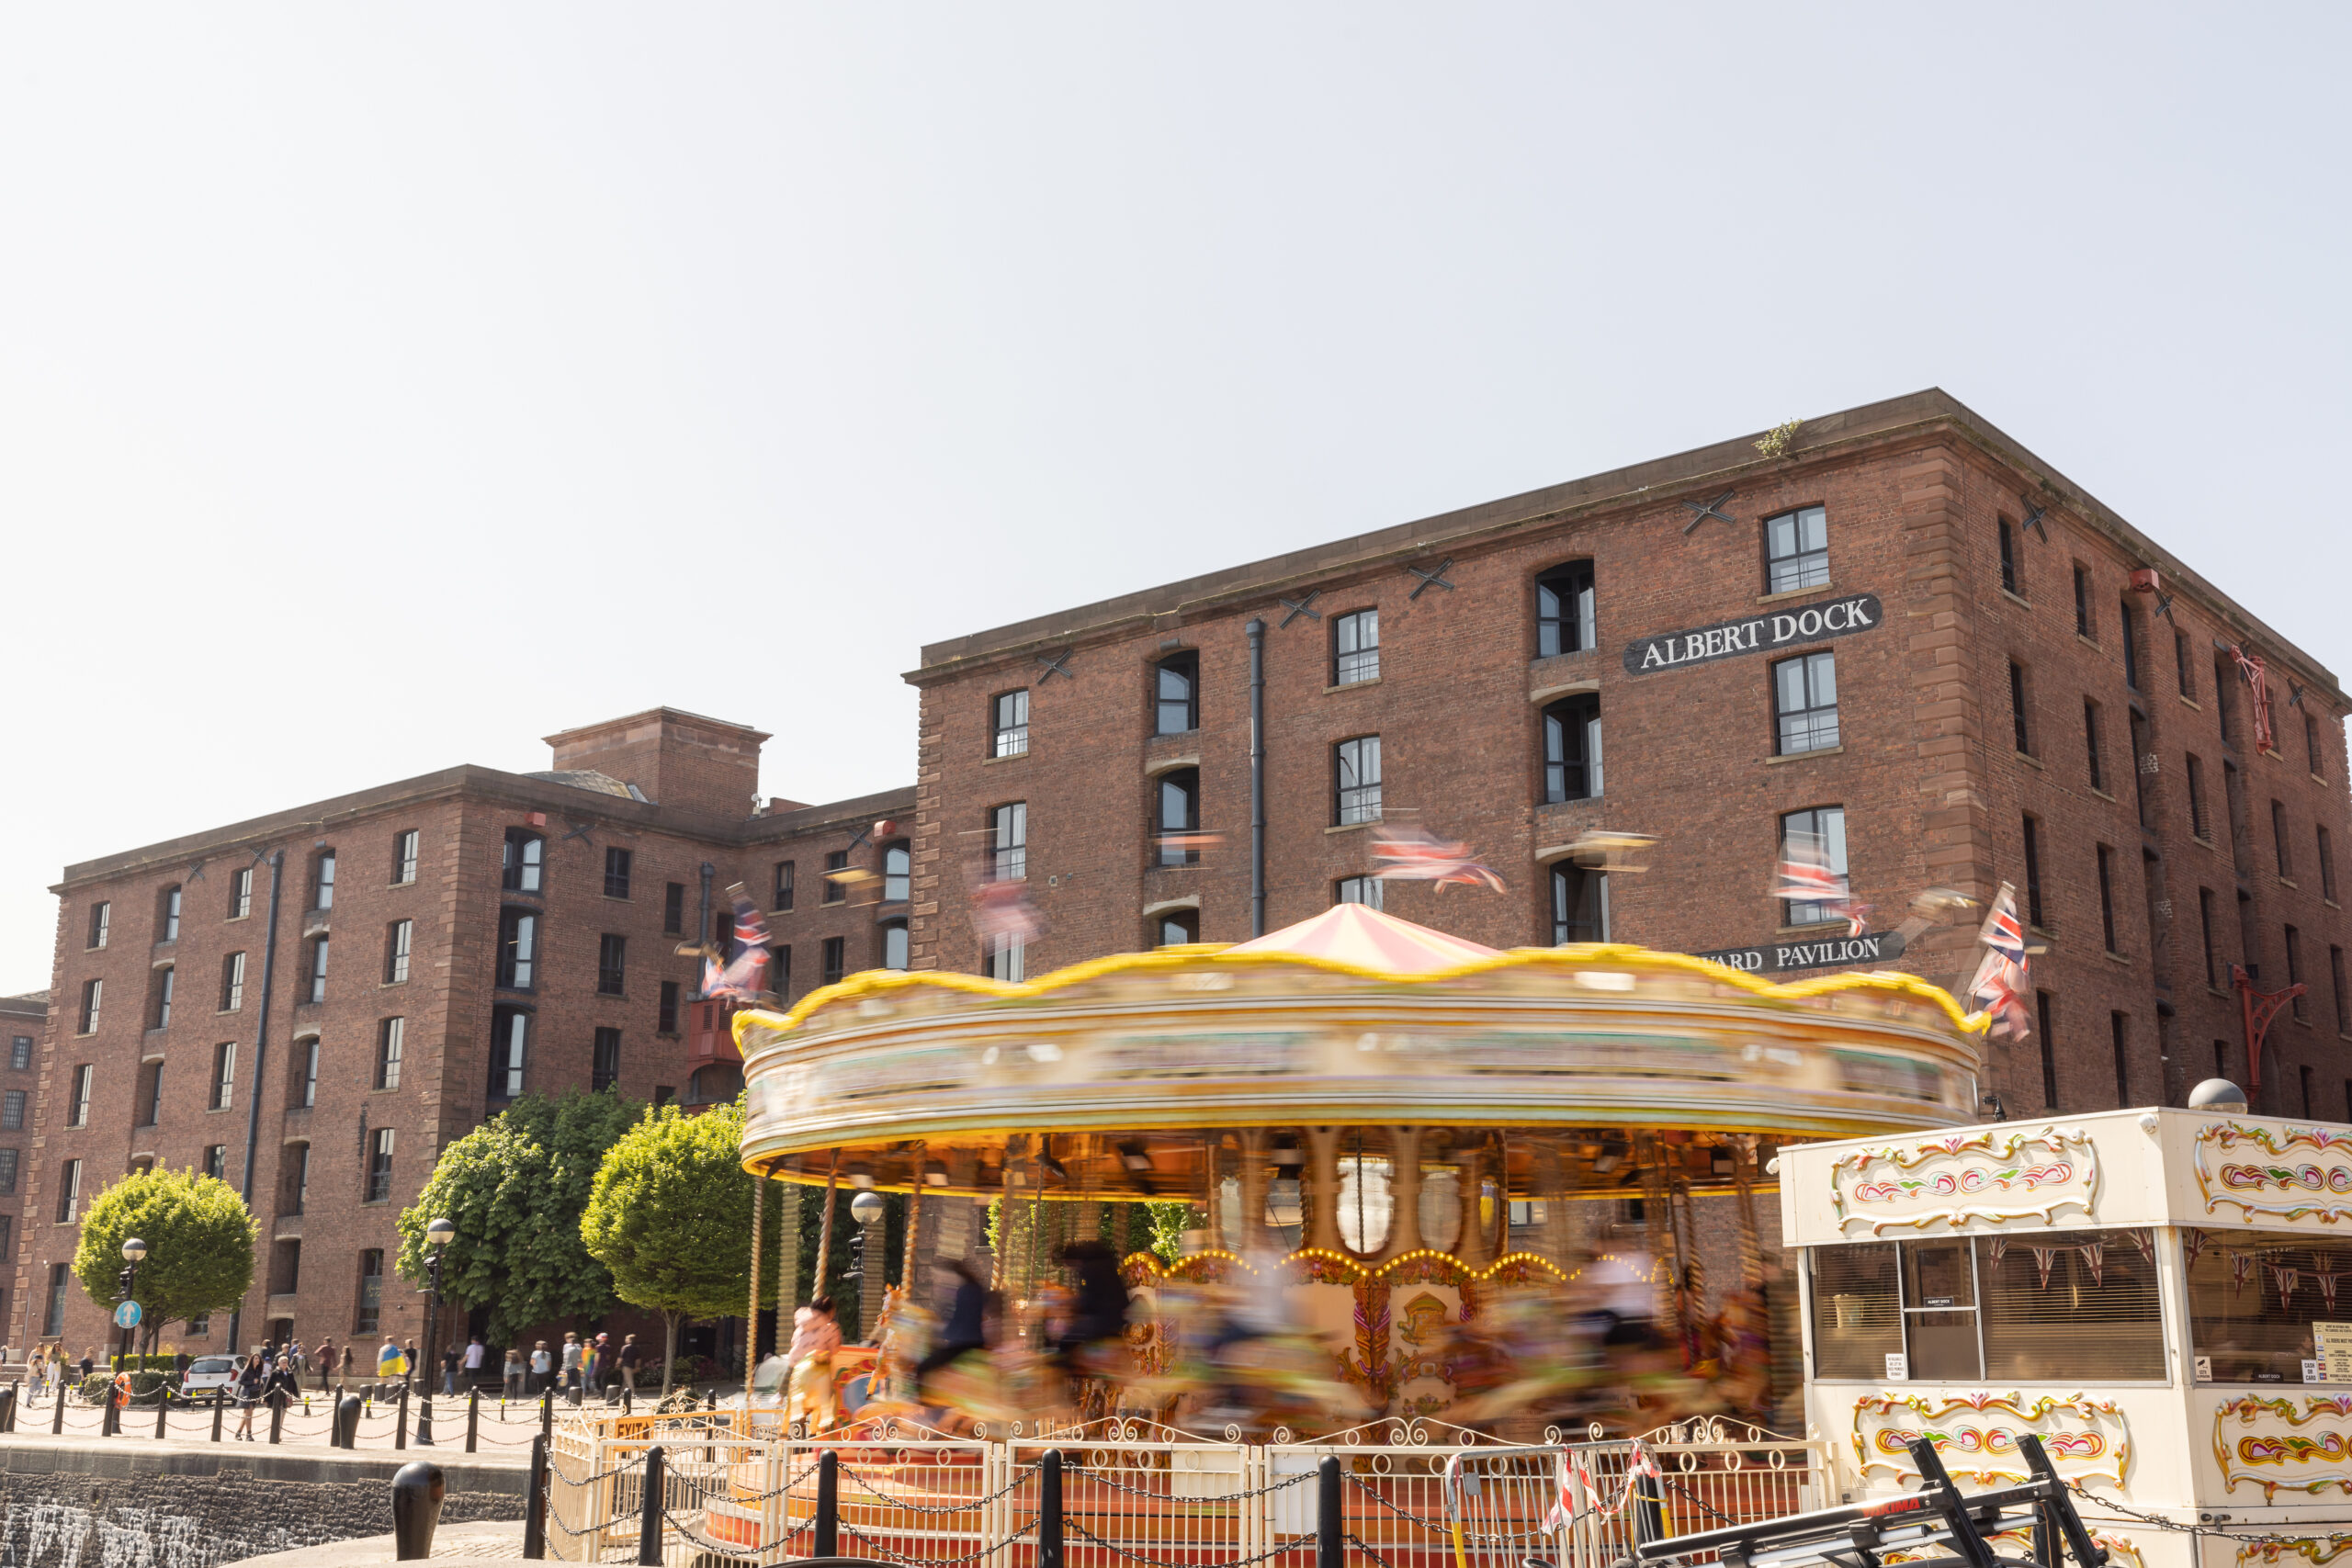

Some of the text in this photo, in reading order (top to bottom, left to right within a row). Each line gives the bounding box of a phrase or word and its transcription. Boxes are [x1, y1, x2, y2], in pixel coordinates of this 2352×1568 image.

[1640, 598, 1872, 670] ALBERT DOCK
[1776, 937, 1881, 967] PAVILION
[617, 1422, 642, 1439] EXIT
[1861, 1497, 1921, 1517] YAKIMA
